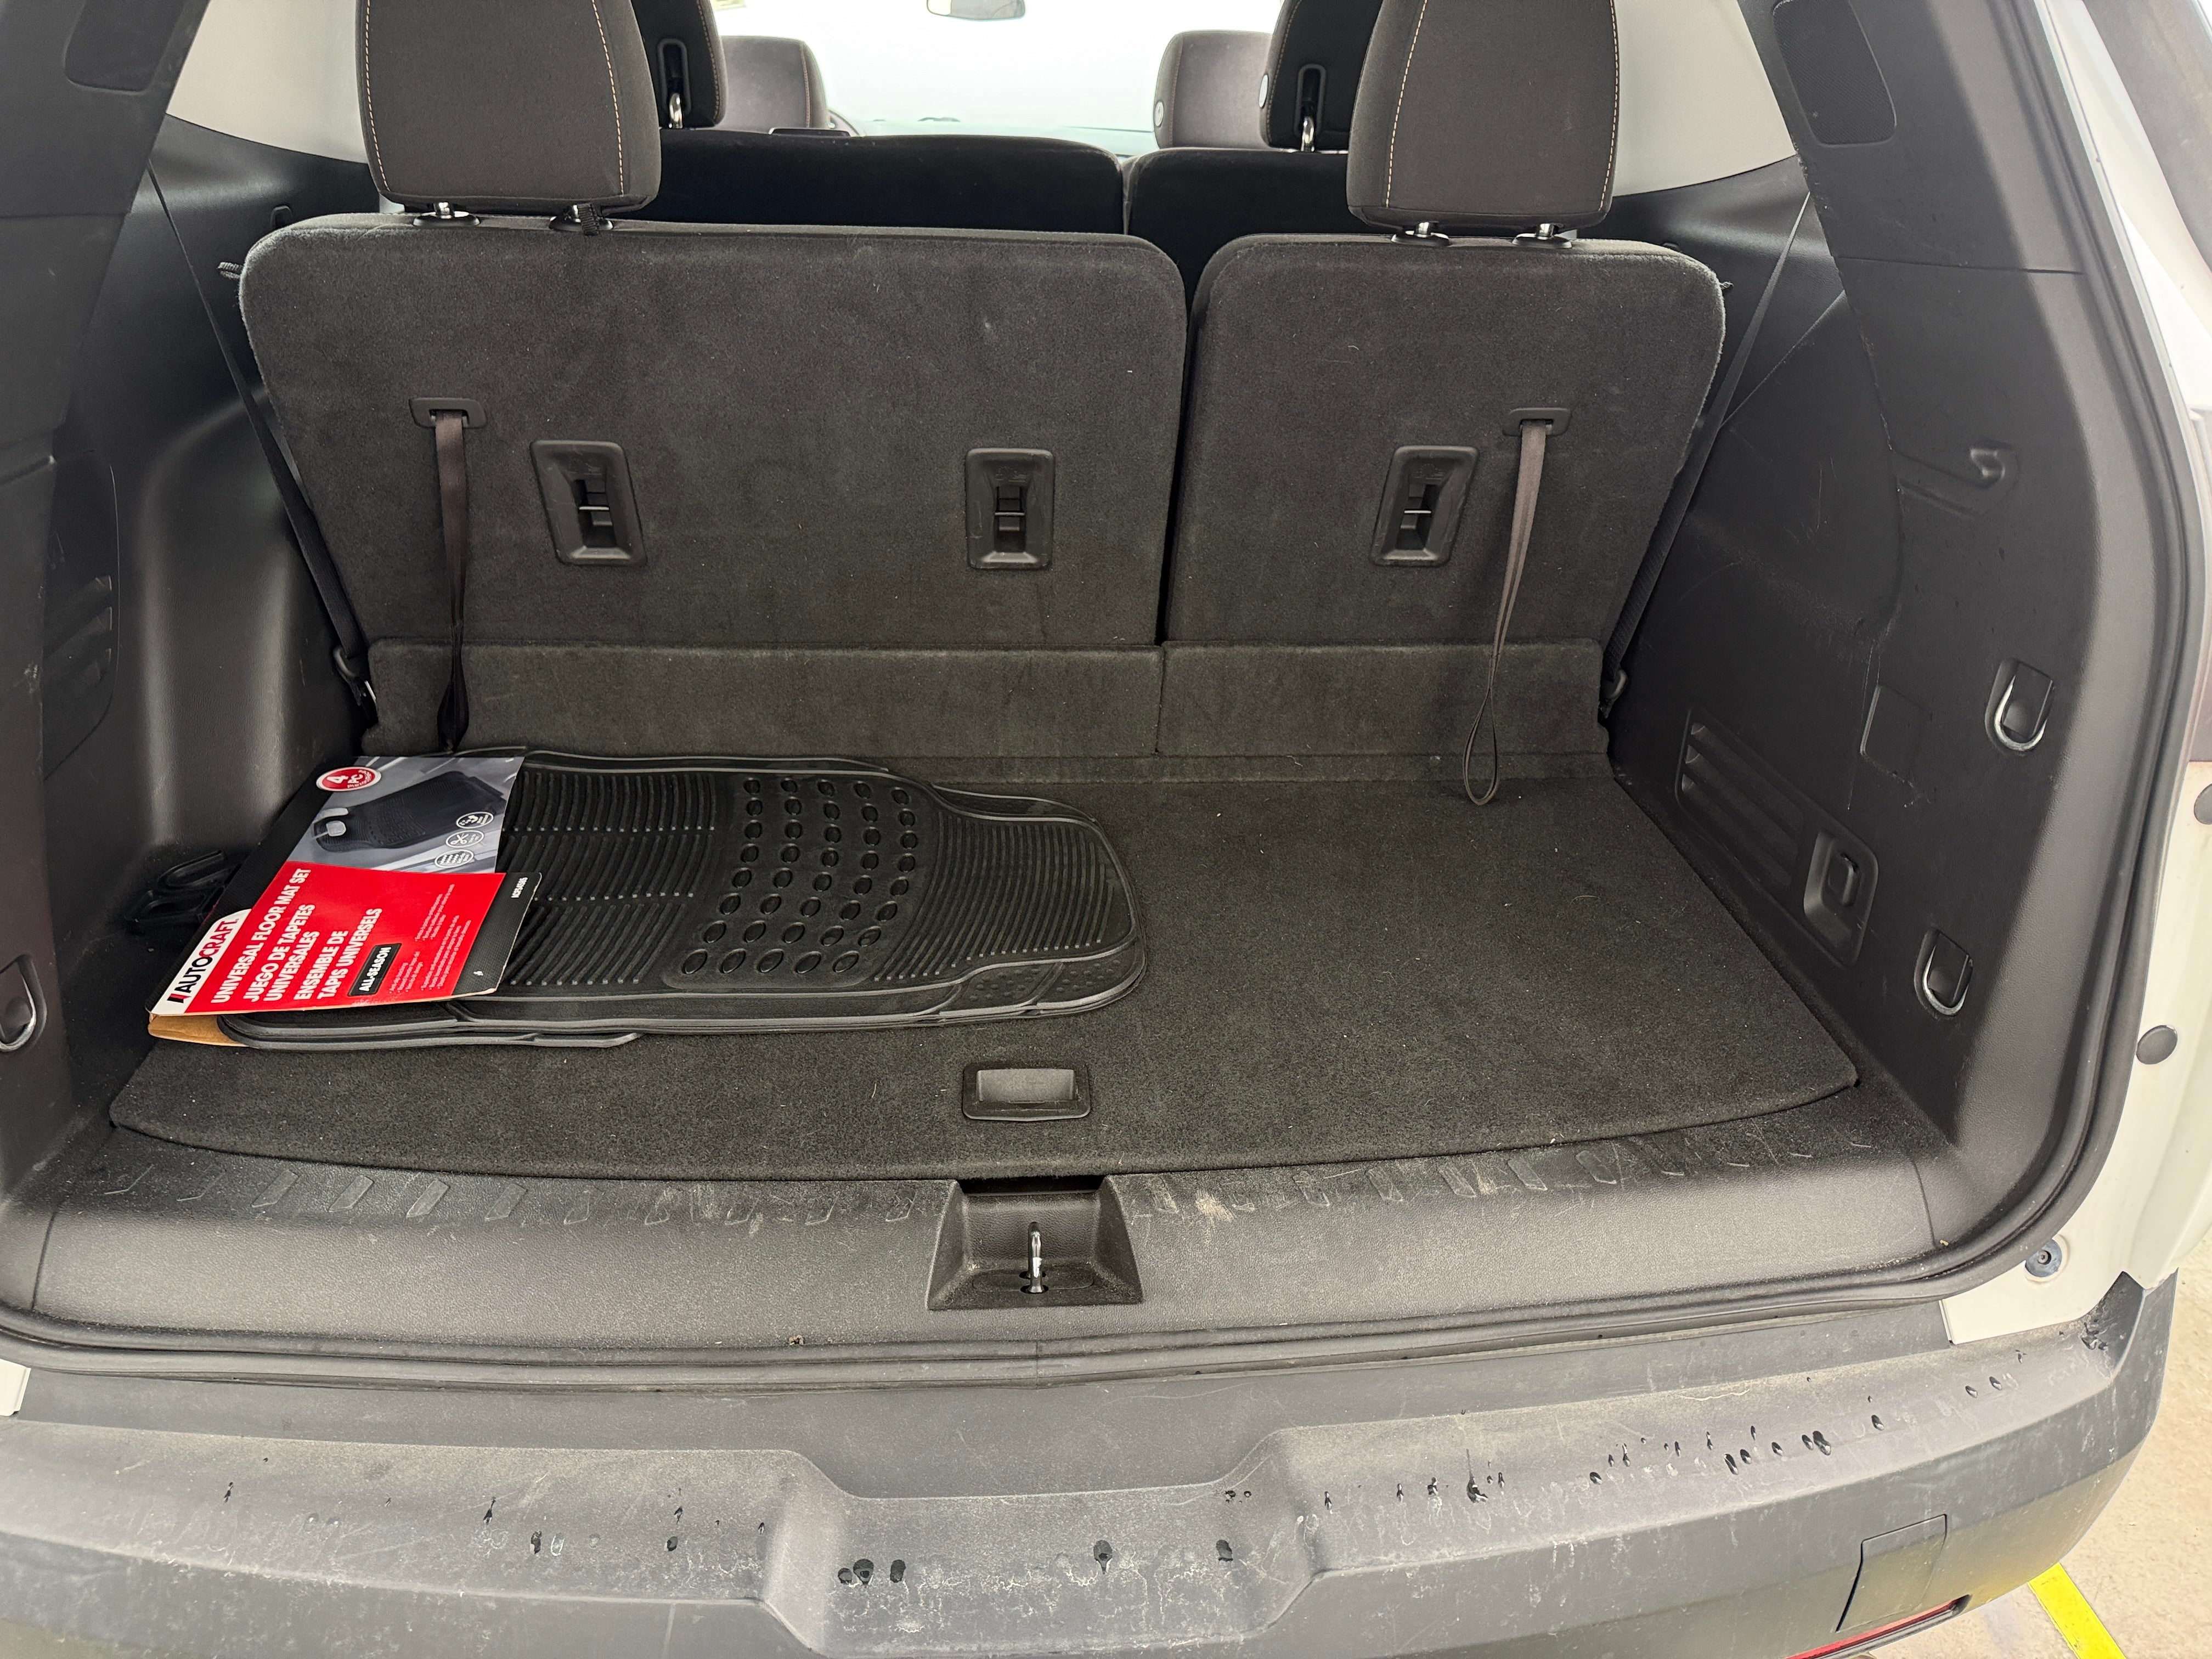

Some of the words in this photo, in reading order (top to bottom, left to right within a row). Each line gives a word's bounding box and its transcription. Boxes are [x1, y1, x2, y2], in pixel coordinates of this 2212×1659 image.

[348, 774, 364, 783] PC
[211, 943, 264, 1003] UNIVERSAL
[252, 907, 286, 940] FLOOR
[275, 885, 300, 904] MAT
[290, 869, 311, 883] SET
[278, 905, 315, 944] TAPETES
[174, 921, 238, 993] AUTOCRAFT
[264, 932, 319, 1001] UNIVERSALES
[268, 946, 290, 960] DE
[294, 946, 340, 1000] ENSEMBLE
[327, 931, 348, 944] DE
[318, 969, 349, 999] TAPIS
[337, 909, 382, 967] UNIVERSELS
[360, 947, 392, 991] ALL-SEASON
[244, 963, 279, 1002] JUEGO
